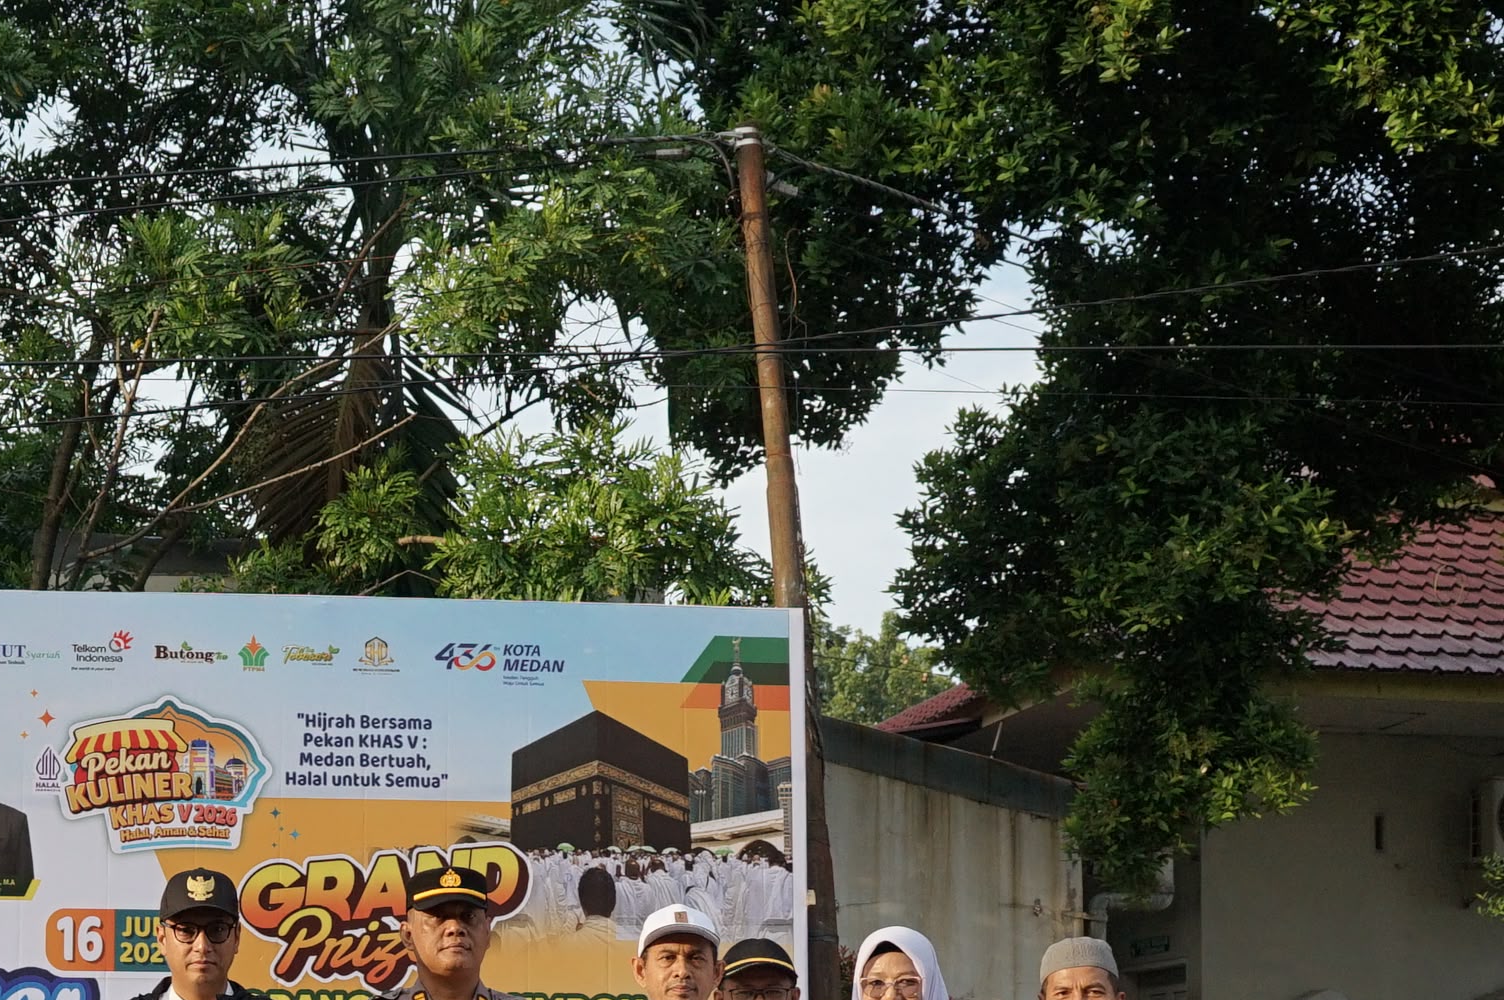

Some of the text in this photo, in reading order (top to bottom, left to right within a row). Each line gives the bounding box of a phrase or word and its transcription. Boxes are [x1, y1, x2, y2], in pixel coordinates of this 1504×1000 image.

[71, 643, 106, 652] Telkom
[154, 645, 215, 663] Butong
[503, 644, 540, 657] KOTA
[76, 653, 123, 662] Indonesia
[503, 659, 565, 672] MEDAN
[297, 713, 432, 731] "Hijrah Bersama
[303, 733, 354, 748] Pekan
[358, 734, 404, 749] KHAS
[407, 735, 419, 749] V
[81, 748, 172, 781] Pekan
[299, 753, 431, 771] Medan Bertuah,
[285, 771, 449, 788] Halal untuk Semua"
[64, 772, 195, 814] KULINER
[109, 804, 238, 829] KHAS V 2026
[120, 827, 230, 842] Halal, Aman & Sehat
[56, 916, 161, 962] 16 JU
[276, 907, 416, 984] Priz
[119, 942, 164, 963] 202
